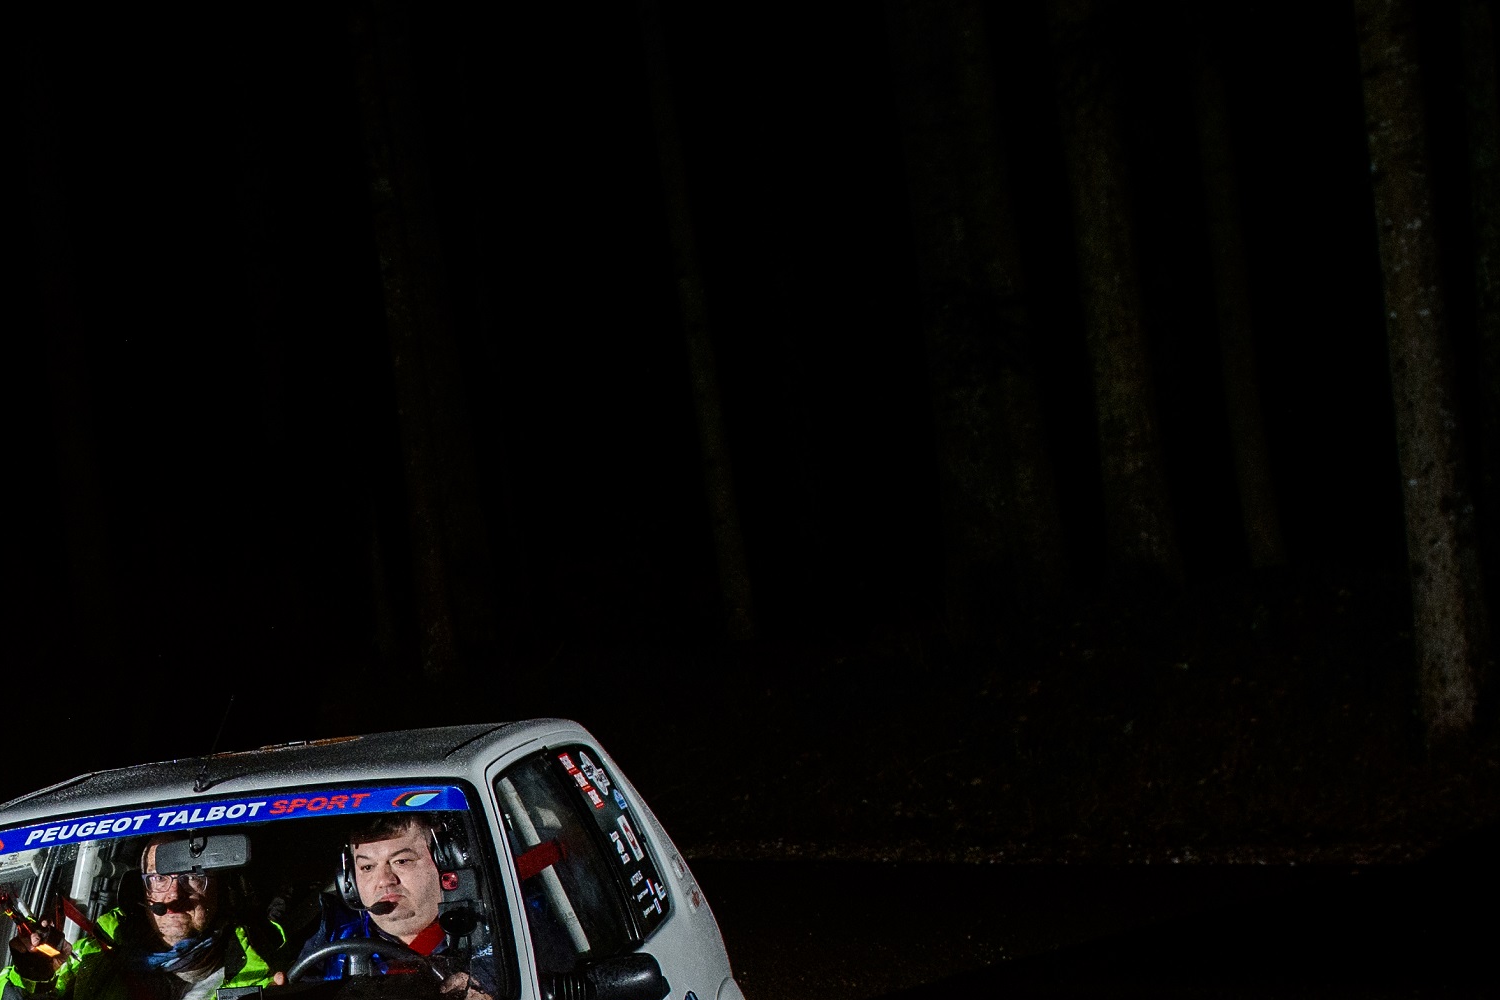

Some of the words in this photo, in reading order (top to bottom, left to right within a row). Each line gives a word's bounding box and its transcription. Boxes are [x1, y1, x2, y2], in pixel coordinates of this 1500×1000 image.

[24, 815, 151, 845] PEUGEOT
[157, 801, 266, 827] TALBOT
[269, 793, 370, 815] SPORT
